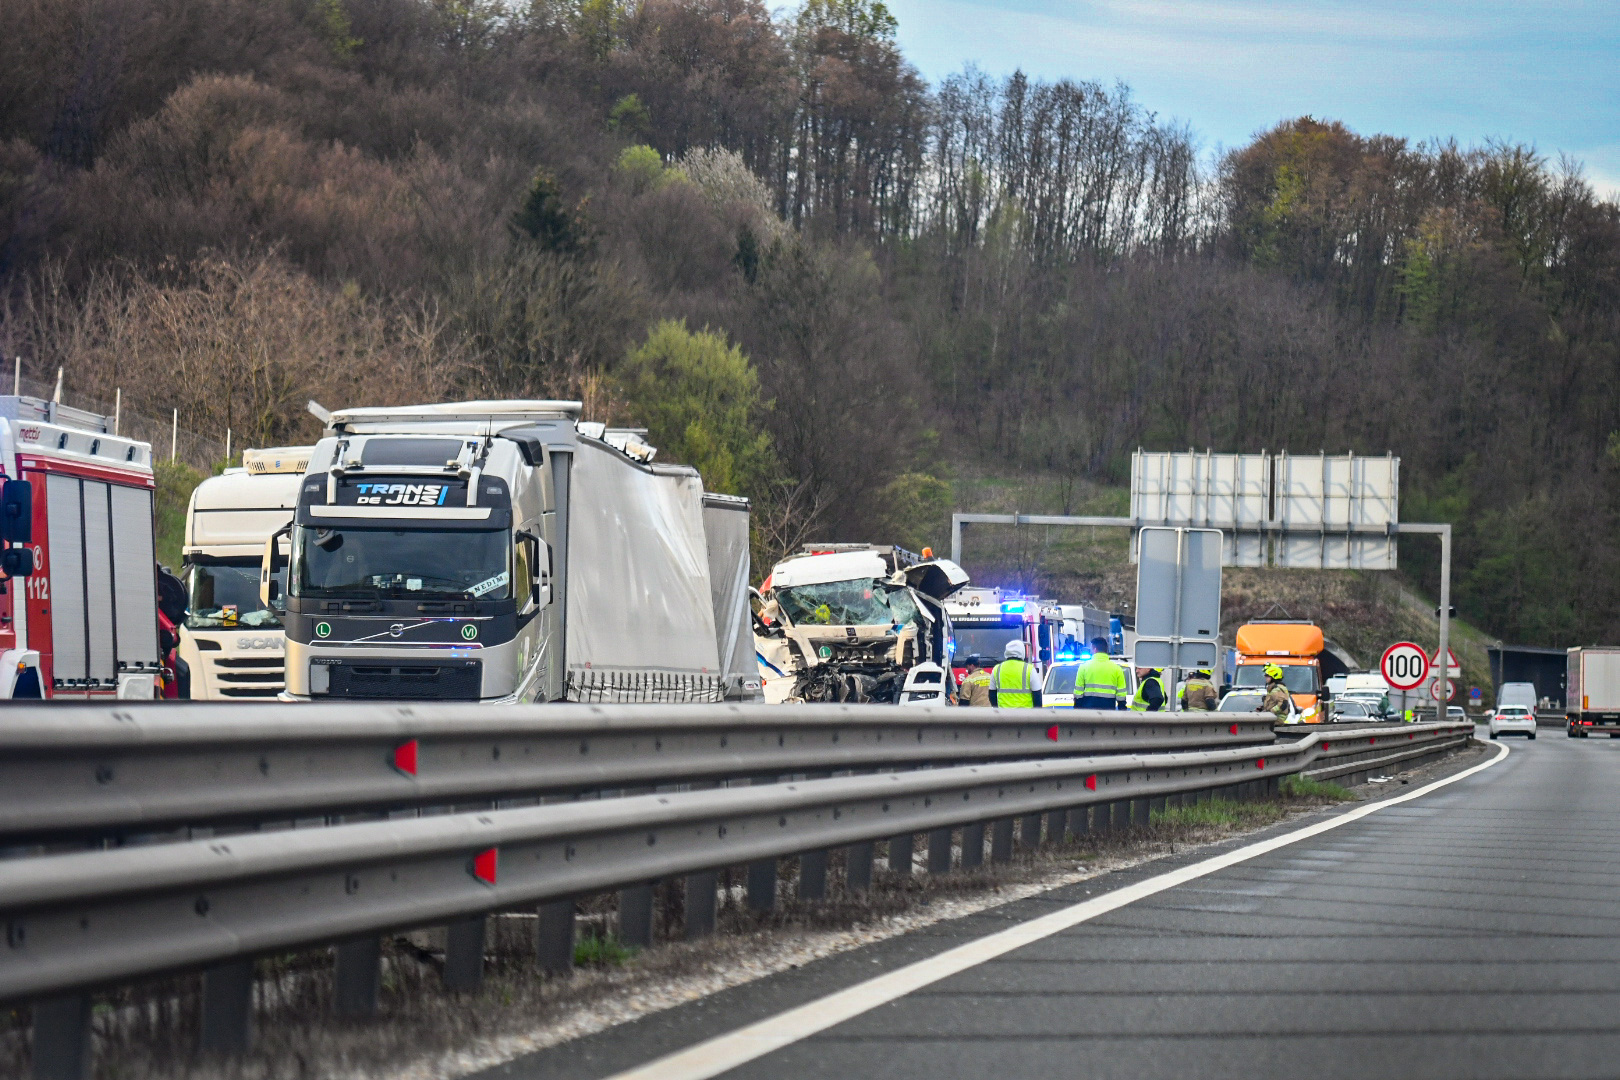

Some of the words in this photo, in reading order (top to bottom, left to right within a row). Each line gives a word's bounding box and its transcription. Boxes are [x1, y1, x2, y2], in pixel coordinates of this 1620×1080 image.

[356, 484, 441, 495] TRANS
[385, 494, 438, 505] JUS
[27, 577, 48, 600] 112
[474, 576, 504, 592] NEDIM
[320, 625, 327, 635] L
[464, 627, 475, 637] VI
[837, 651, 875, 659] MAN
[1388, 655, 1422, 678] 100
